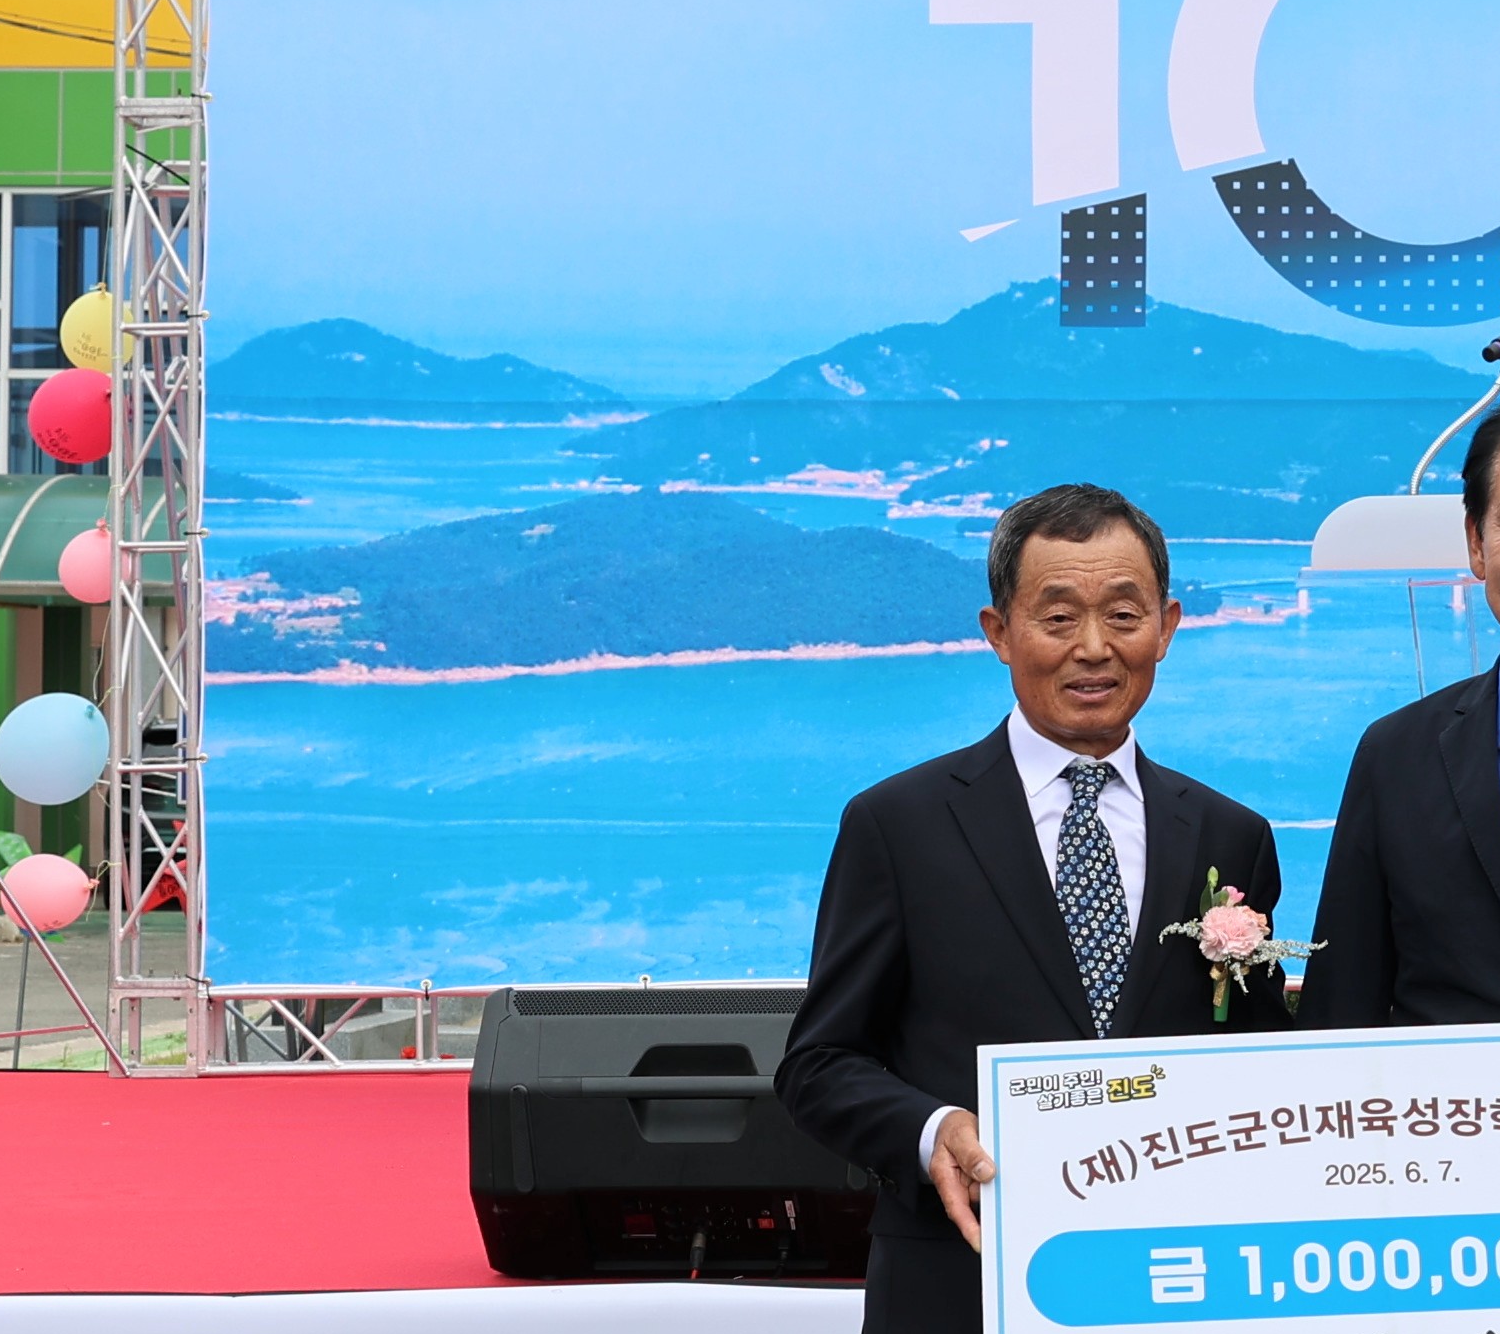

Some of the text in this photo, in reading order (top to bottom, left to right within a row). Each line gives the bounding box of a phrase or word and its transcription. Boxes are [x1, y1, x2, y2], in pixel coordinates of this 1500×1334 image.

[1009, 1068, 1103, 1097] 군민이 주인!
[1037, 1074, 1157, 1111] 살기좋은 진도
[1324, 1159, 1461, 1188] 2025. 6. 7.
[1148, 1246, 1207, 1305] 금
